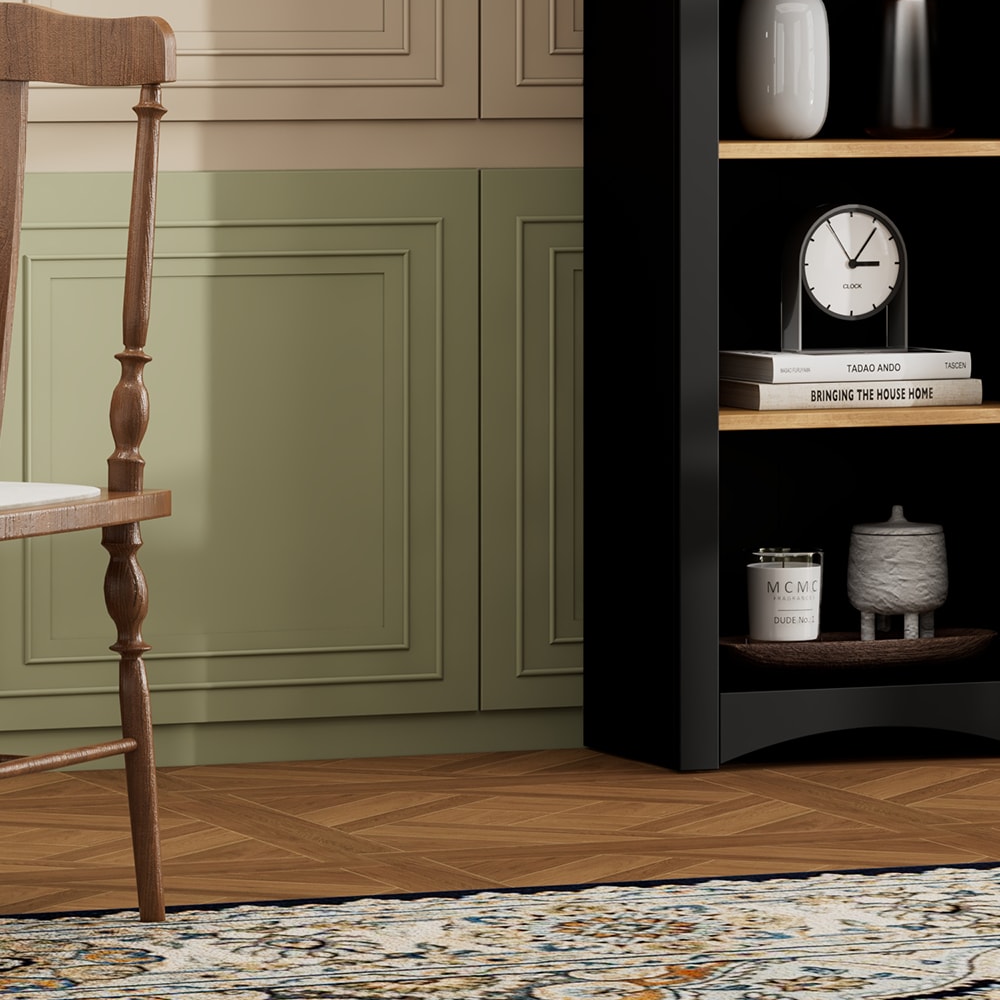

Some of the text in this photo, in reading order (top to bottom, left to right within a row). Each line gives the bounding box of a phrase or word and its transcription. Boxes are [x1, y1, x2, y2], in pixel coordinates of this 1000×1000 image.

[847, 363, 901, 373] TADAO ANDO
[811, 387, 934, 402] BRINGING THE HOUSE HOME
[773, 616, 797, 625] DUDE
